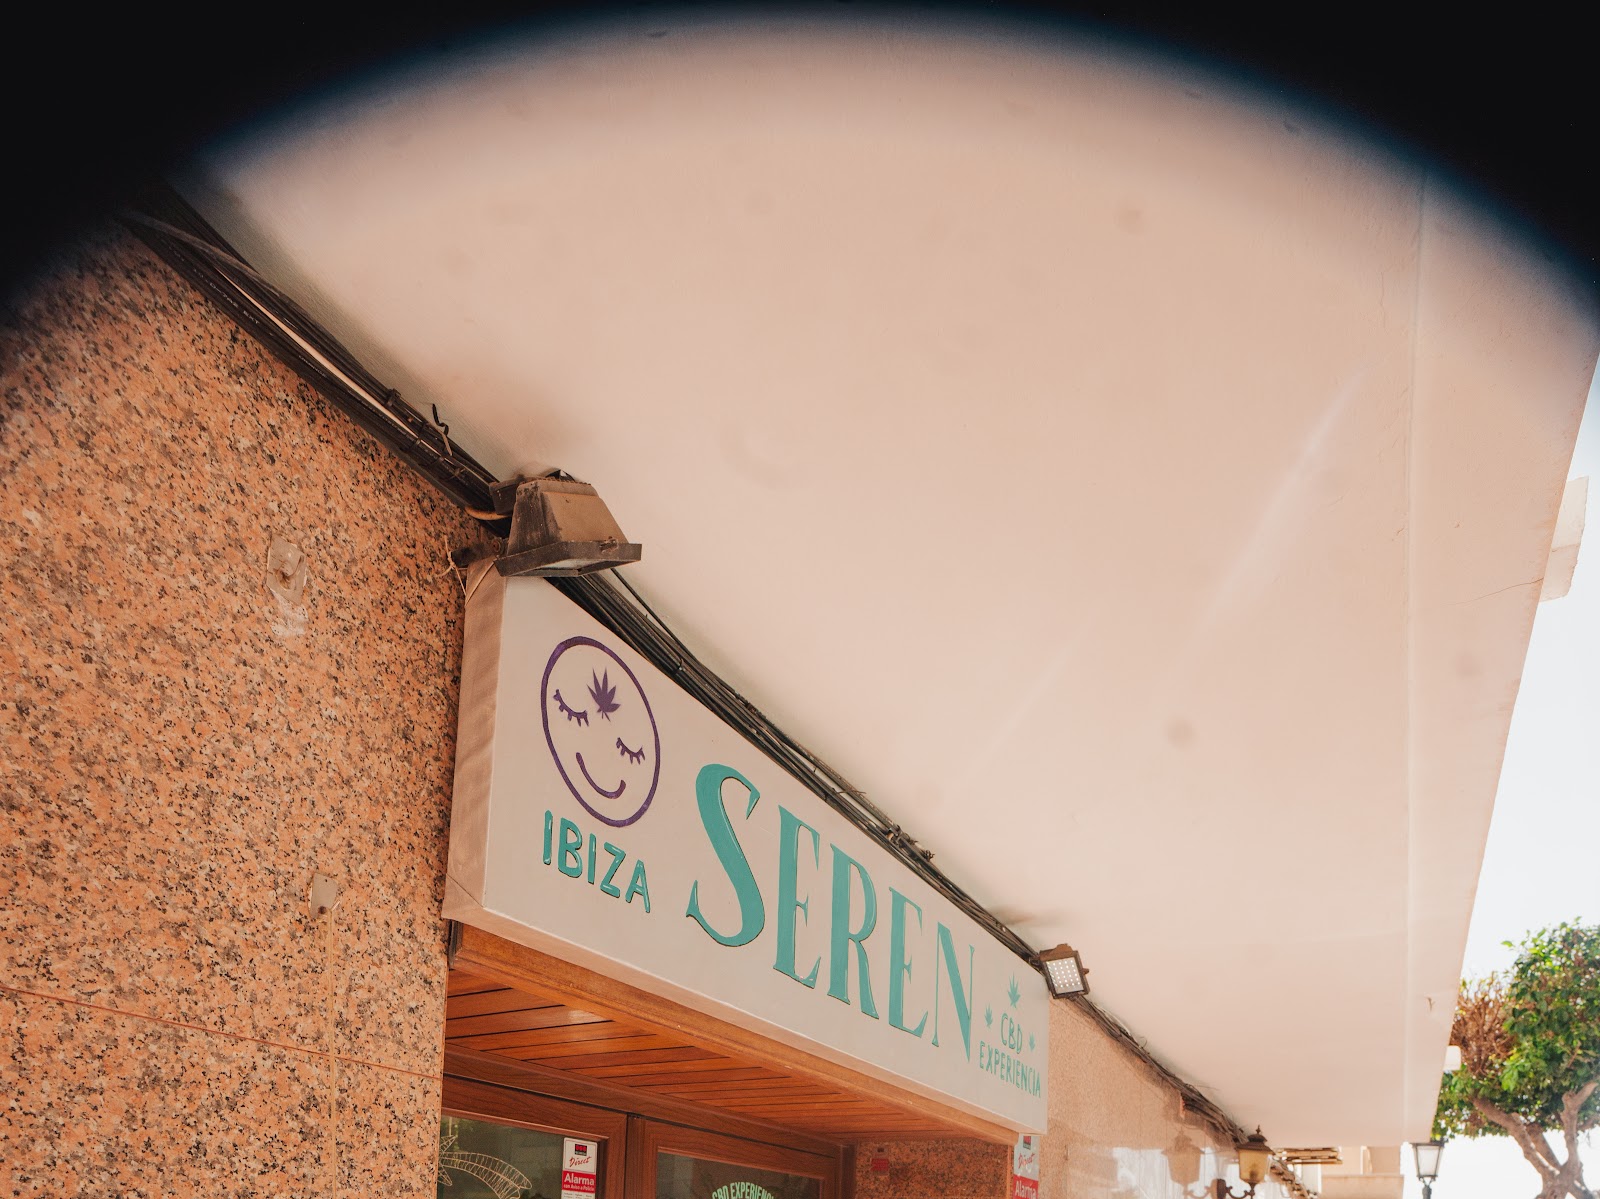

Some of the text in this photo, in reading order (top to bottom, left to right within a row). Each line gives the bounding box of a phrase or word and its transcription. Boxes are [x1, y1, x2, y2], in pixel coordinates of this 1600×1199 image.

[543, 809, 651, 914] IBIZA
[686, 763, 975, 1064] SEREN
[1000, 1012, 1023, 1055] CBD
[979, 1040, 1042, 1099] EXPERIENCIA
[564, 1172, 595, 1186] Alarma
[569, 1156, 592, 1168] Direct
